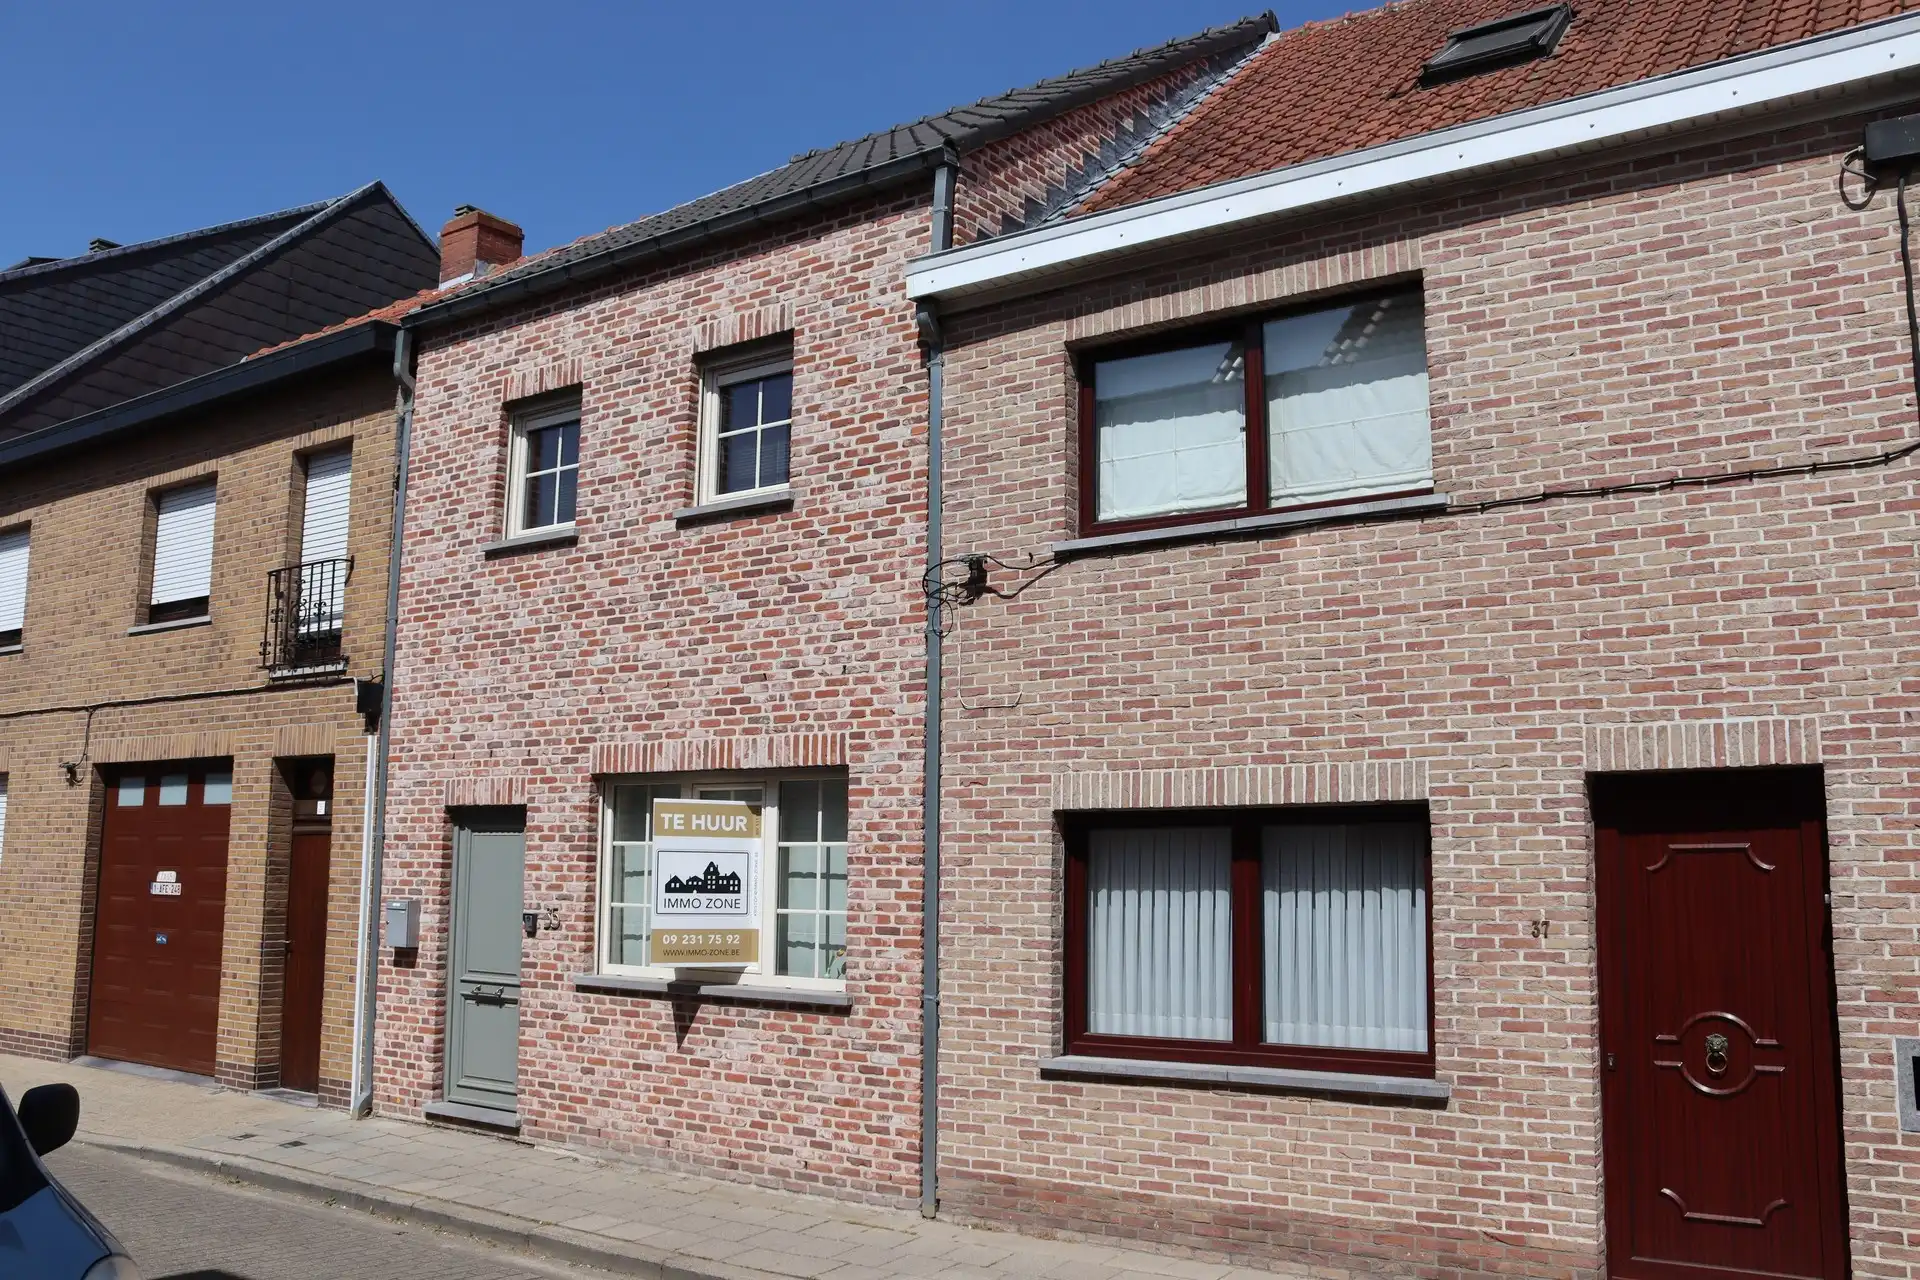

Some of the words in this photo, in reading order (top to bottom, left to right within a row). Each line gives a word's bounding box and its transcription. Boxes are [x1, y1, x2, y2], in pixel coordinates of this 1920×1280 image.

[660, 813, 685, 830] TE
[691, 814, 748, 832] HUUR
[663, 897, 702, 909] IMMO
[705, 898, 741, 909] ZONE
[544, 907, 561, 930] 35
[1531, 920, 1551, 939] 37
[662, 934, 678, 945] 09
[682, 934, 703, 945] 231
[707, 934, 722, 945] 75
[726, 934, 740, 945] 92
[662, 948, 741, 957] WWW.IMMO-ZONE.BE
